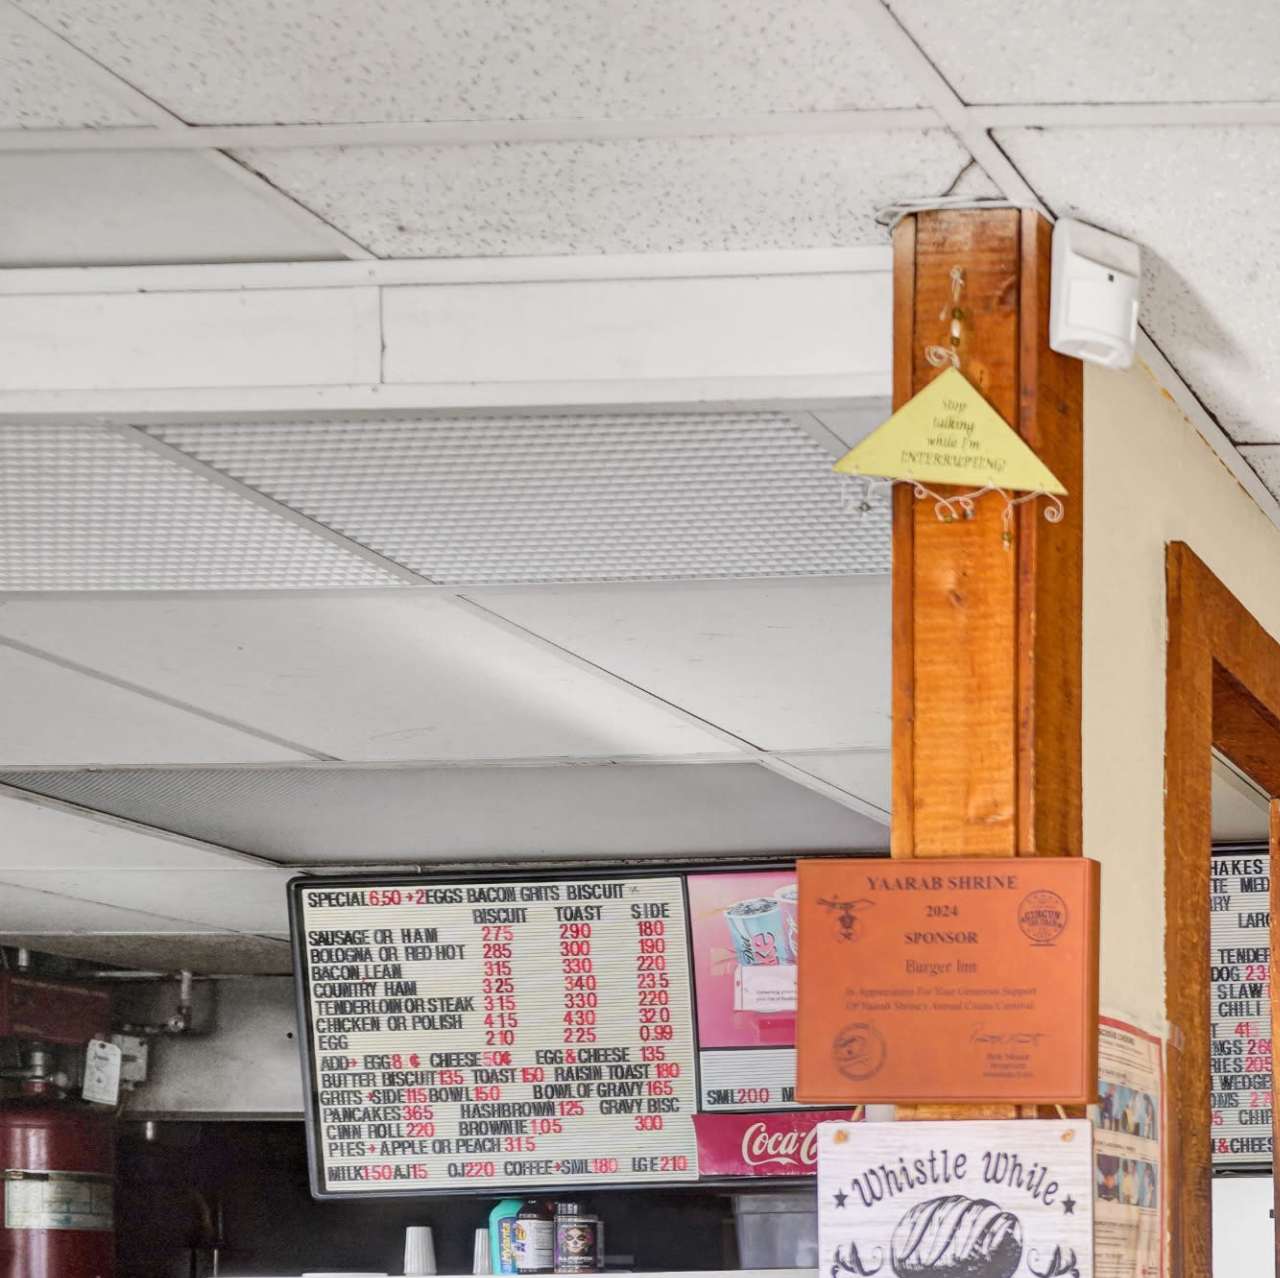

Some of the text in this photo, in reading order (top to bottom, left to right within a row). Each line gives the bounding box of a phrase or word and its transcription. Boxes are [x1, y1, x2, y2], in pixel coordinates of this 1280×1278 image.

[867, 875, 1018, 891] YAARAB SHRINE
[308, 892, 368, 907] SPECIAL
[467, 887, 515, 903] BACON
[520, 885, 559, 901] GRITS
[566, 883, 624, 900] BISCUIT
[472, 903, 670, 924] BISCUIT TOAST SIDE
[926, 905, 960, 918] 2024
[308, 920, 664, 946] SAUSAGE OR HAM 275 290 180
[904, 931, 979, 945] SPONSOR
[311, 938, 665, 964] BOLOGNA OR RED HOT 285 300 190
[484, 955, 666, 977] 315 330 220
[905, 959, 977, 976] Burger Inn
[313, 973, 670, 999] COUNTRY HAM 325 340 235
[1217, 982, 1263, 1000] SLAW
[405, 998, 425, 1014] OR
[428, 996, 475, 1013] STEAK
[484, 996, 516, 1012] 315
[564, 992, 598, 1009] 330
[638, 990, 669, 1007] 220
[1218, 1001, 1262, 1017] CHILI
[316, 1007, 671, 1034] CHICKEN OR POLISH 415 430 320
[318, 1024, 673, 1051] EGG 210 225 0.99
[429, 1052, 481, 1068] CHEESE
[640, 1046, 665, 1062] 135
[321, 1072, 376, 1089] BUTTER
[473, 1066, 545, 1084] TOAST 150
[554, 1062, 680, 1082] RAISIN TOAST 180
[320, 1090, 363, 1106] GRITS
[533, 1080, 674, 1100] BOWL OF GRAVY 165
[707, 1089, 737, 1106] SML
[738, 1087, 770, 1104] 200
[323, 1105, 434, 1123] PANCAKES 365
[460, 1100, 585, 1119] HASHBROWN 125
[600, 1097, 680, 1115] GRAVY BISC
[326, 1121, 435, 1140] CINN ROLL 220
[458, 1119, 528, 1136] BROWNIE
[634, 1115, 664, 1131] 300
[328, 1136, 536, 1158] PIES APPLE OR PEACH 315
[742, 1122, 818, 1167] Coca-C
[504, 1160, 552, 1177] COFFEE
[852, 1149, 1061, 1208] Whistle While
